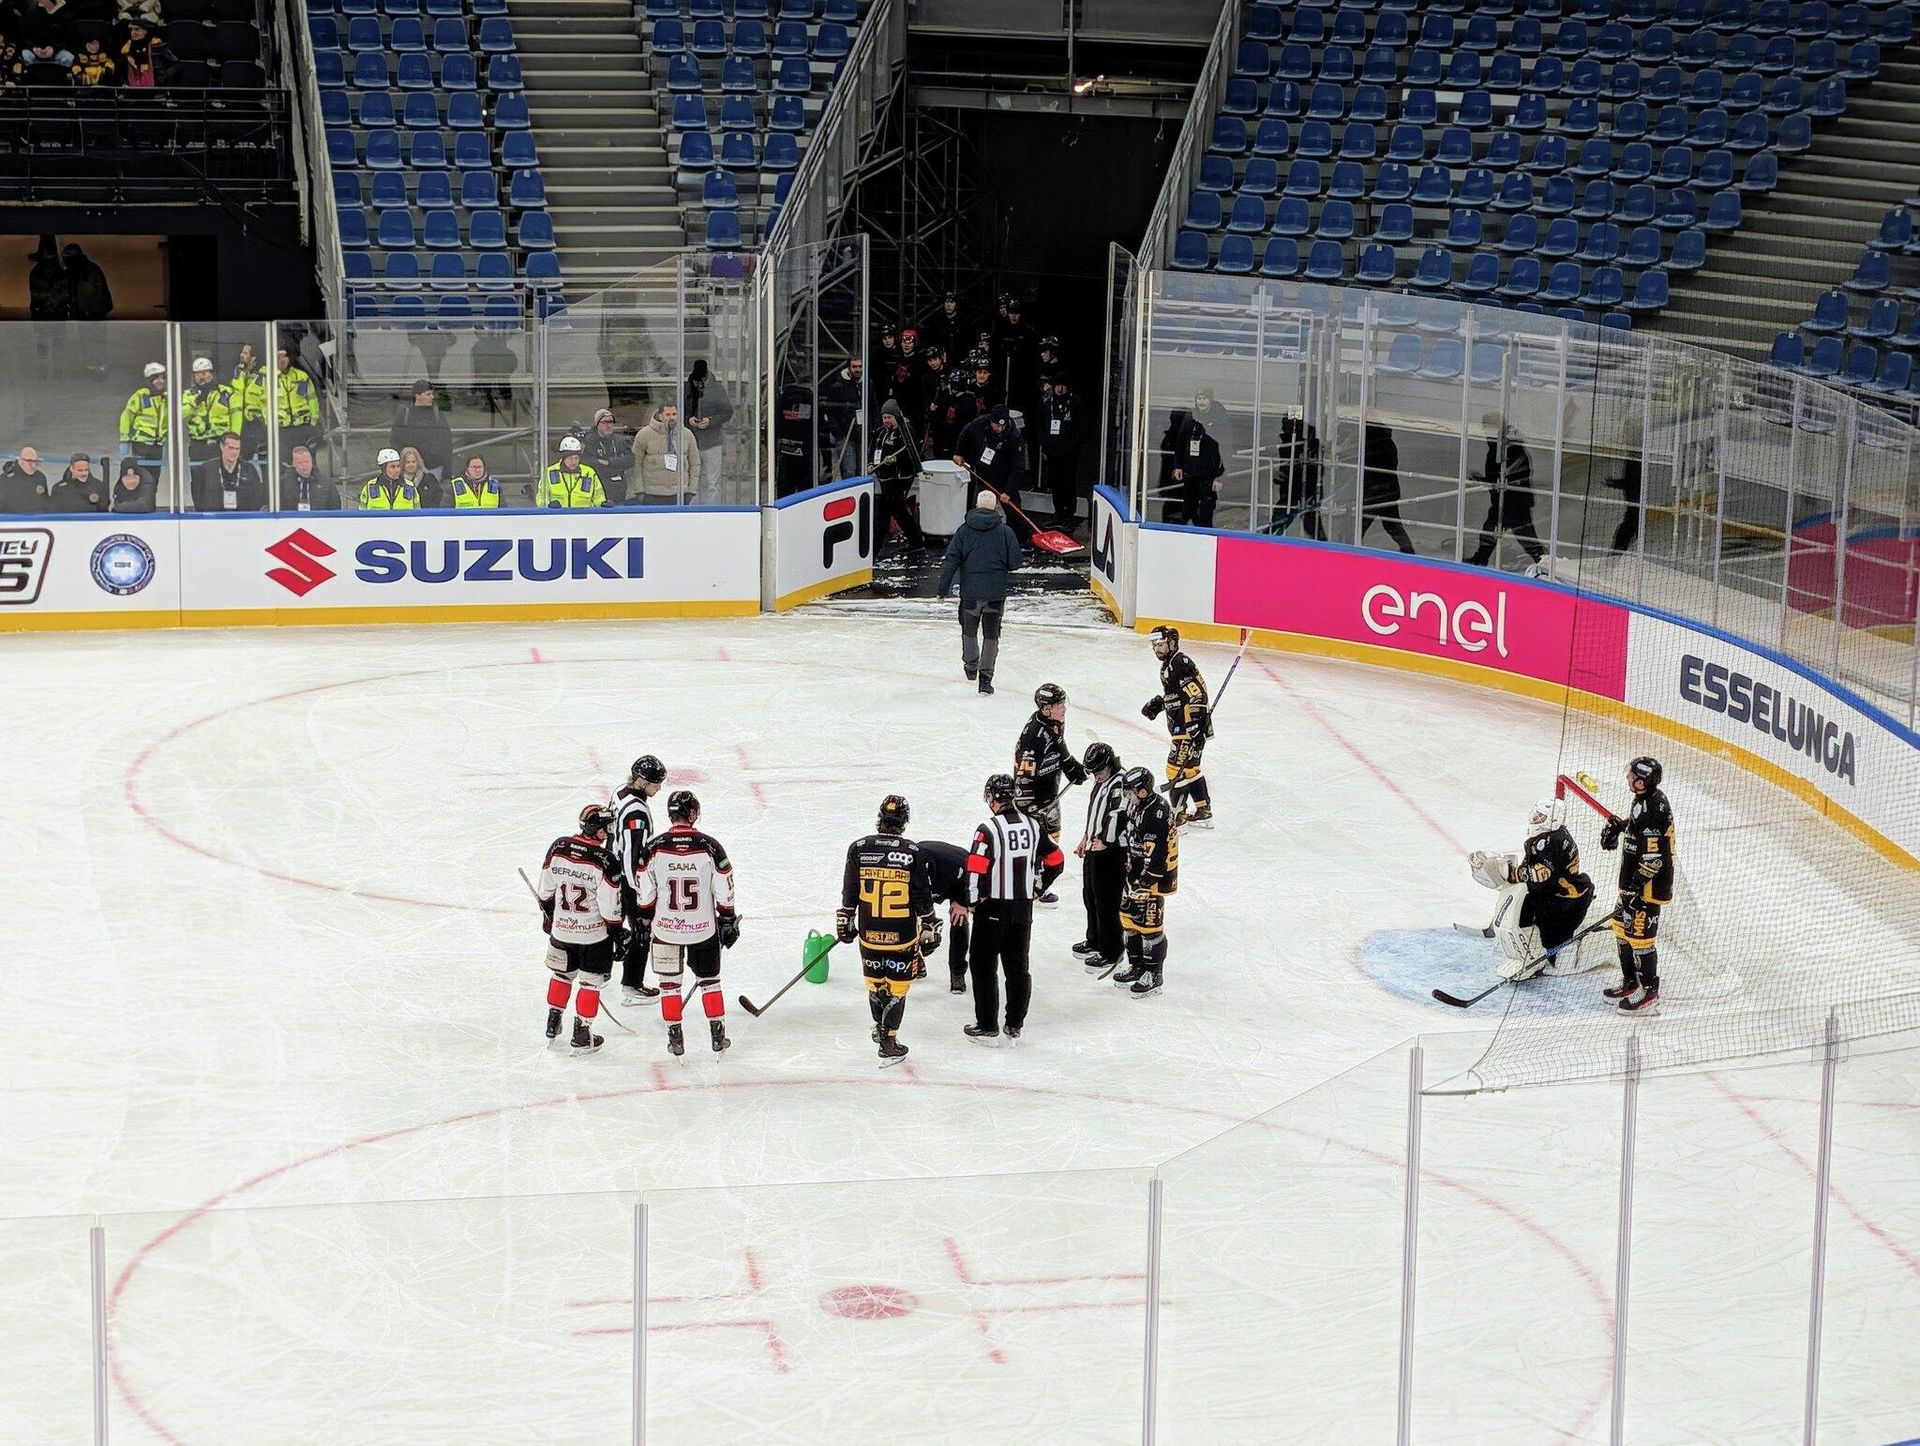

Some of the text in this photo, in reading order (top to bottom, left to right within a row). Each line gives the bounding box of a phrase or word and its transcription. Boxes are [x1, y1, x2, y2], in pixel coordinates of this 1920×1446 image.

[0, 540, 39, 555] EY
[354, 536, 645, 584] SUZUKI
[1361, 584, 1509, 658] enel
[1679, 653, 1856, 787] ESSELUNGA
[1007, 828, 1031, 851] 83
[887, 851, 914, 866] coop
[559, 881, 591, 913] 12
[667, 877, 699, 912] 15
[859, 879, 910, 918] 42
